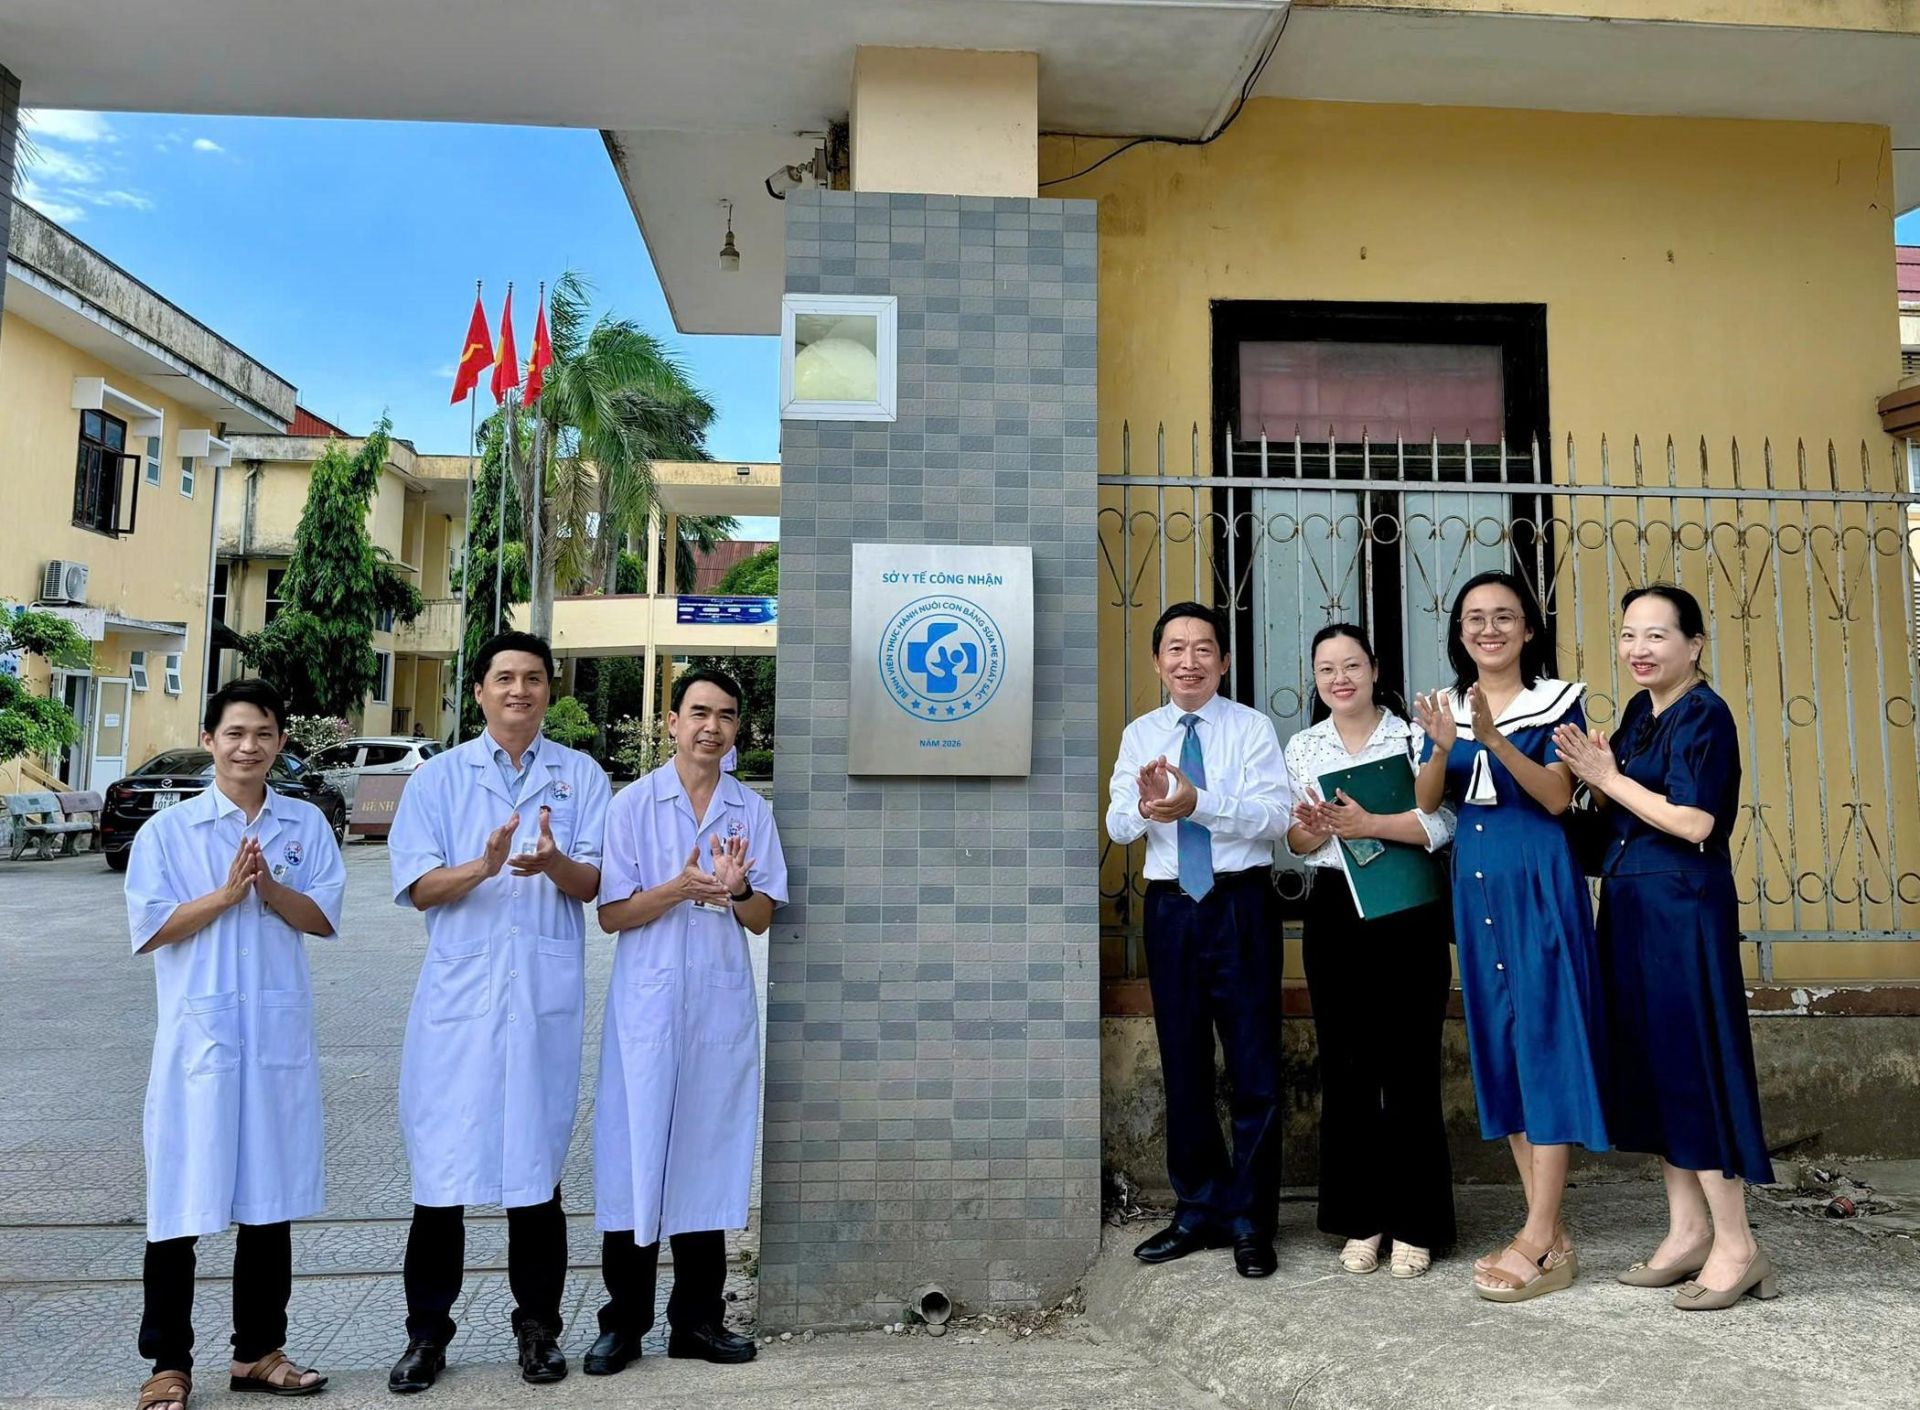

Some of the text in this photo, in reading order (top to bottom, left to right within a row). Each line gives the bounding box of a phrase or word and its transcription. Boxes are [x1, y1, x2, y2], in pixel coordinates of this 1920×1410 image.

[882, 570, 1003, 587] SỞ Y TẾ CÔNG NHẬN
[942, 602, 962, 612] CON
